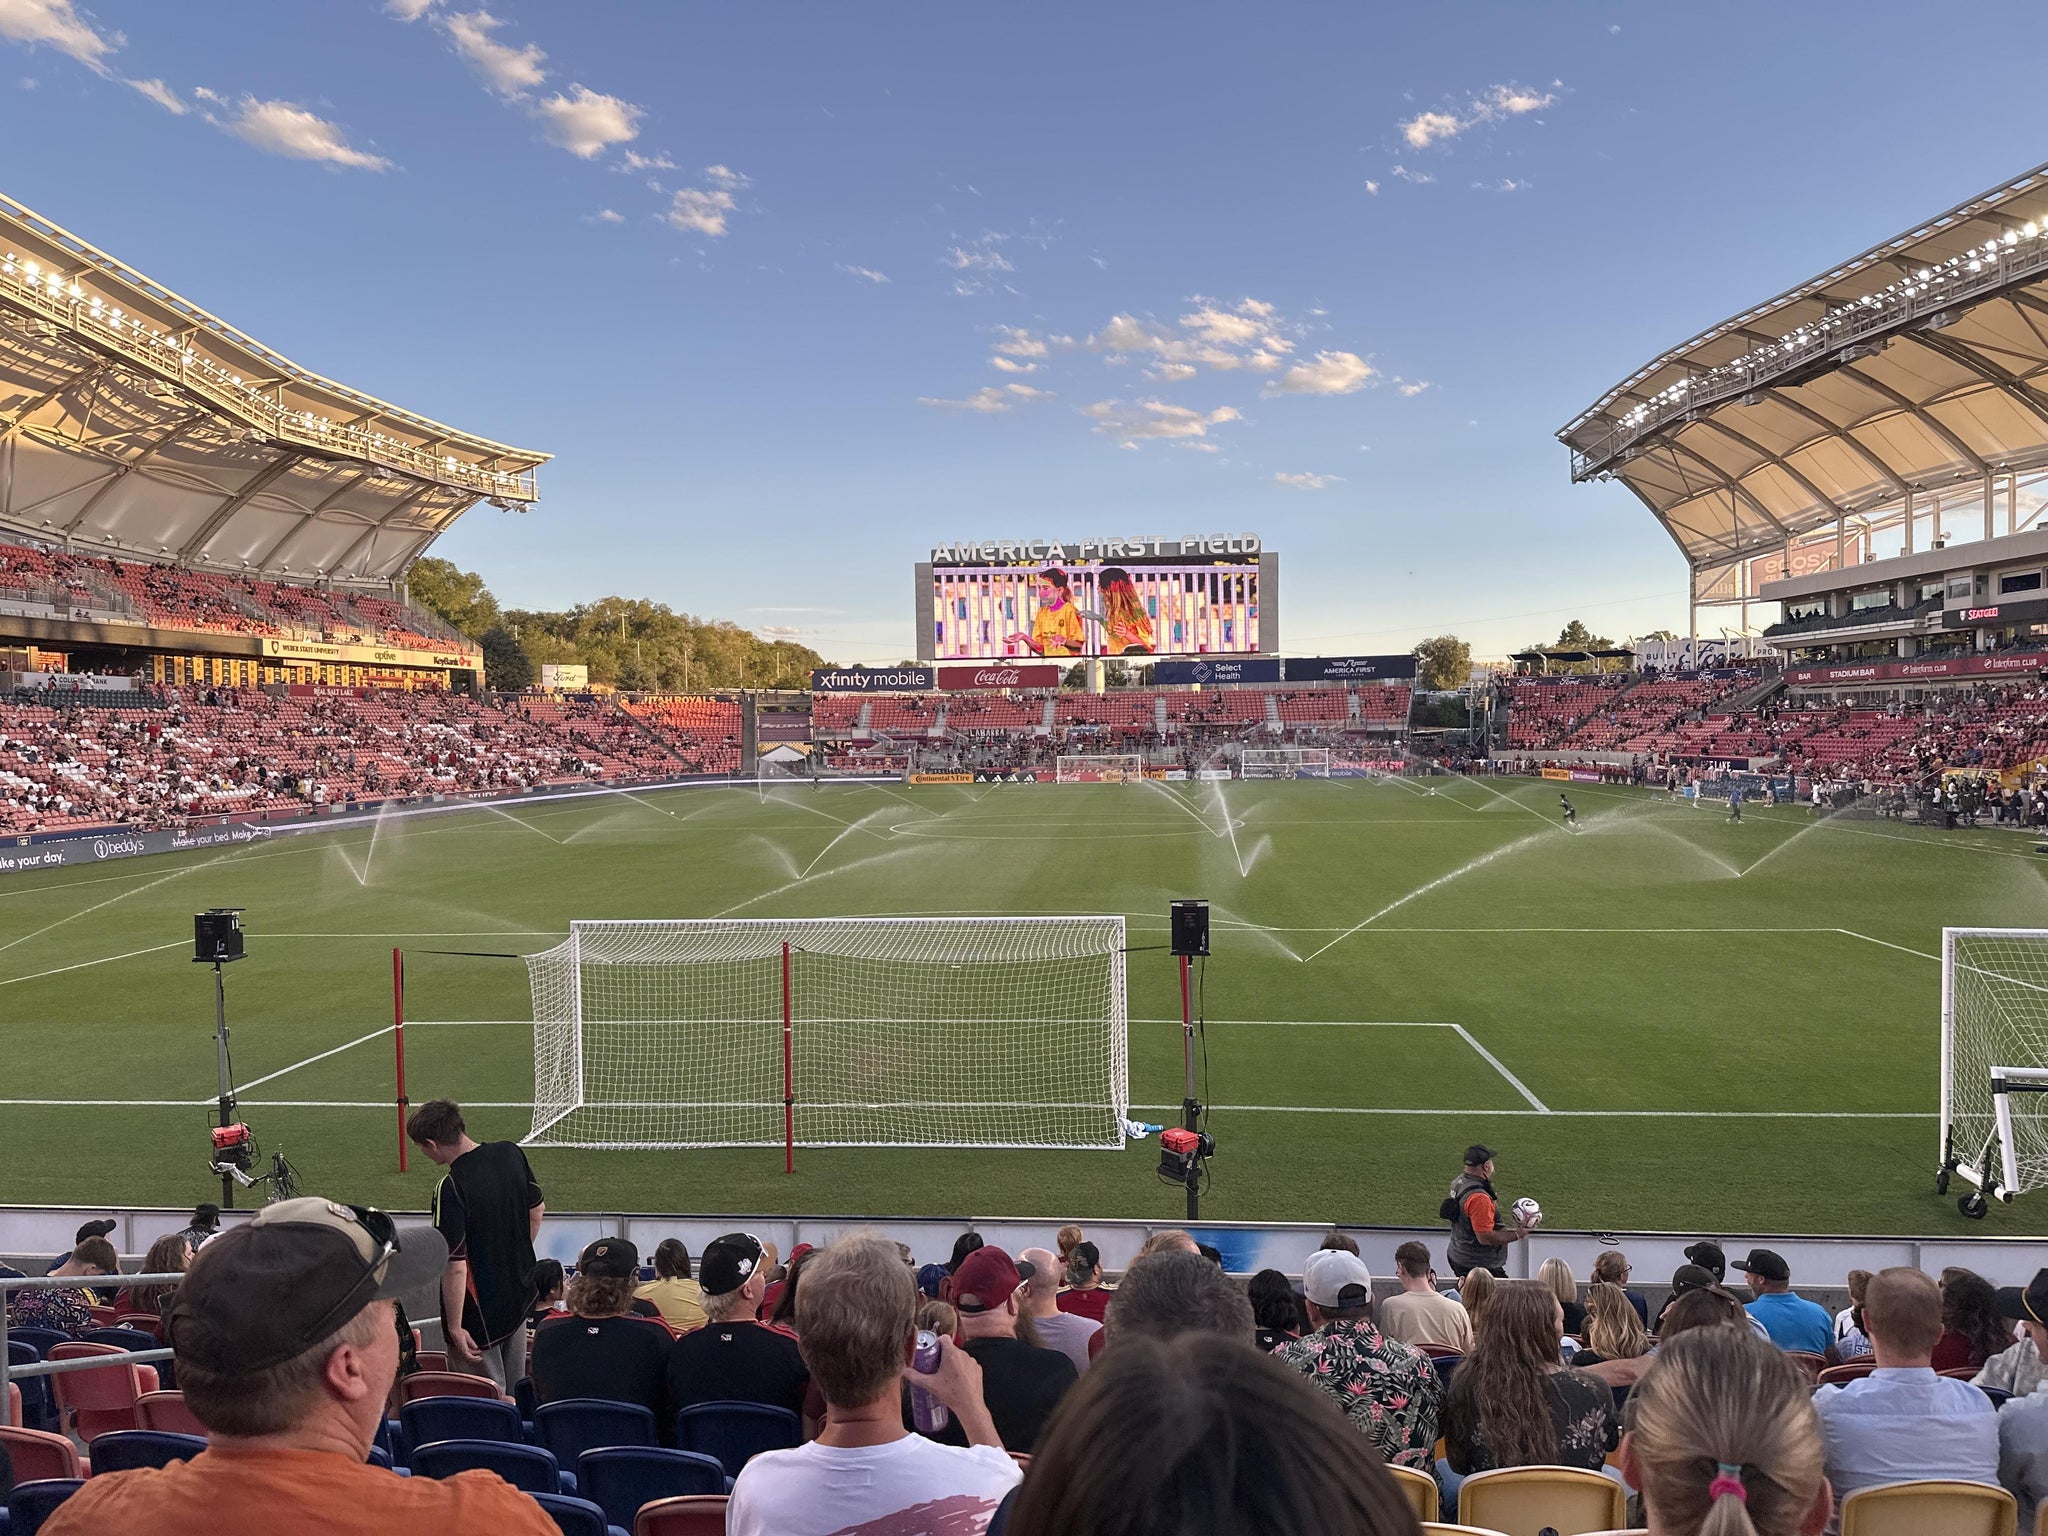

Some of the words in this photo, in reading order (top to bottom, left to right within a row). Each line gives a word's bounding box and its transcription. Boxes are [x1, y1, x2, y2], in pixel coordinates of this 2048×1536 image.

[933, 539, 1067, 563] AMERICA
[1079, 536, 1167, 558] FIRST
[1180, 533, 1261, 556] FIELD
[282, 644, 299, 652] WEBER
[314, 647, 340, 655] UNIVERSITY
[374, 650, 396, 663] aptive
[433, 656, 459, 666] KeyBank
[1215, 664, 1242, 672] Select
[1324, 667, 1355, 675] AMERICA
[1830, 669, 1860, 678] STADIUM
[1860, 668, 1875, 676] BAR
[552, 671, 577, 682] Ford
[820, 672, 871, 689] xfinity
[874, 671, 925, 686] mobile
[1215, 672, 1241, 680] Health
[1657, 673, 1679, 681] Ford
[1559, 677, 1581, 686] Ford
[314, 687, 326, 696] REAL
[327, 688, 339, 696] SALT
[340, 688, 354, 696] LAKE
[519, 696, 541, 704] UTAH
[644, 696, 673, 704] UTAH
[676, 696, 716, 704] ROYALS
[915, 774, 950, 783] Continental
[196, 835, 213, 846] your
[232, 829, 251, 841] Make
[108, 838, 145, 855] beddy's
[17, 855, 41, 869] your
